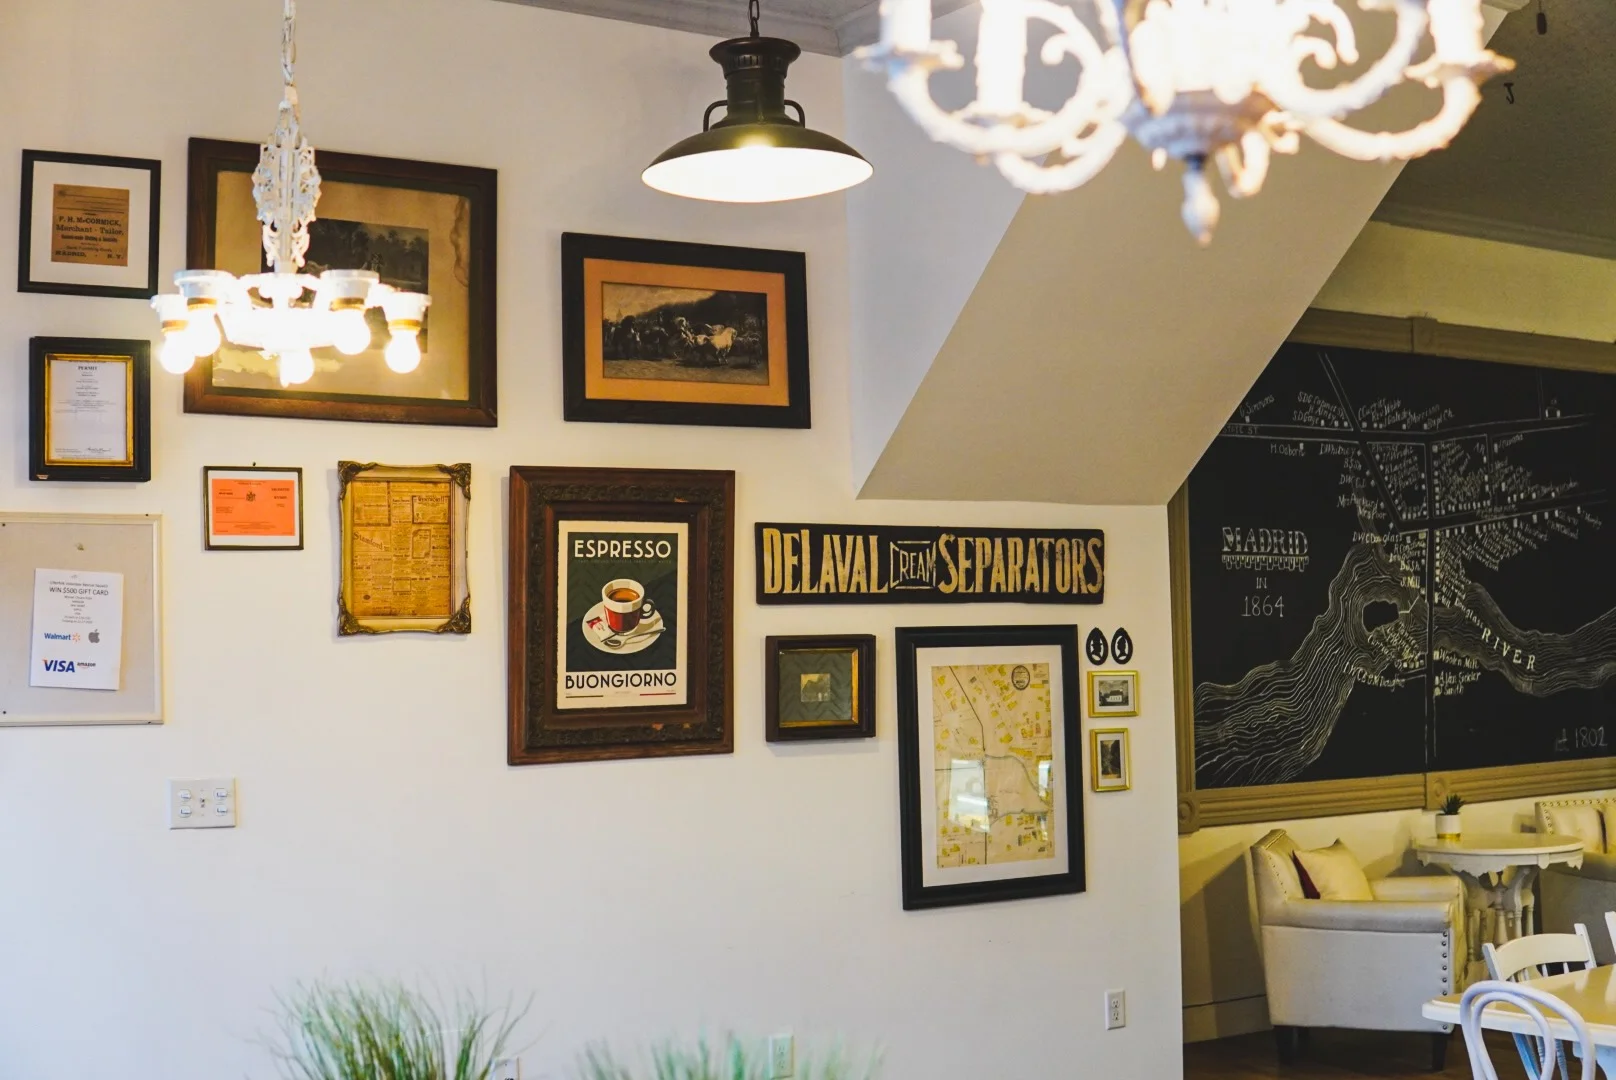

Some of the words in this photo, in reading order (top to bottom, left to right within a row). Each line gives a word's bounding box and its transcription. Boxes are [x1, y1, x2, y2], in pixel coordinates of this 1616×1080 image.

[574, 540, 672, 558] ESPRESSO
[1222, 527, 1308, 554] MADRID
[763, 528, 888, 594] DELAVAL
[938, 533, 1104, 594] SEPARATORS
[1256, 577, 1267, 589] IN
[1241, 595, 1284, 617] 1864
[44, 632, 71, 640] Walmart
[1482, 628, 1536, 672] RIVER
[42, 659, 75, 673] VISA
[566, 672, 677, 690] BUONGIORNO
